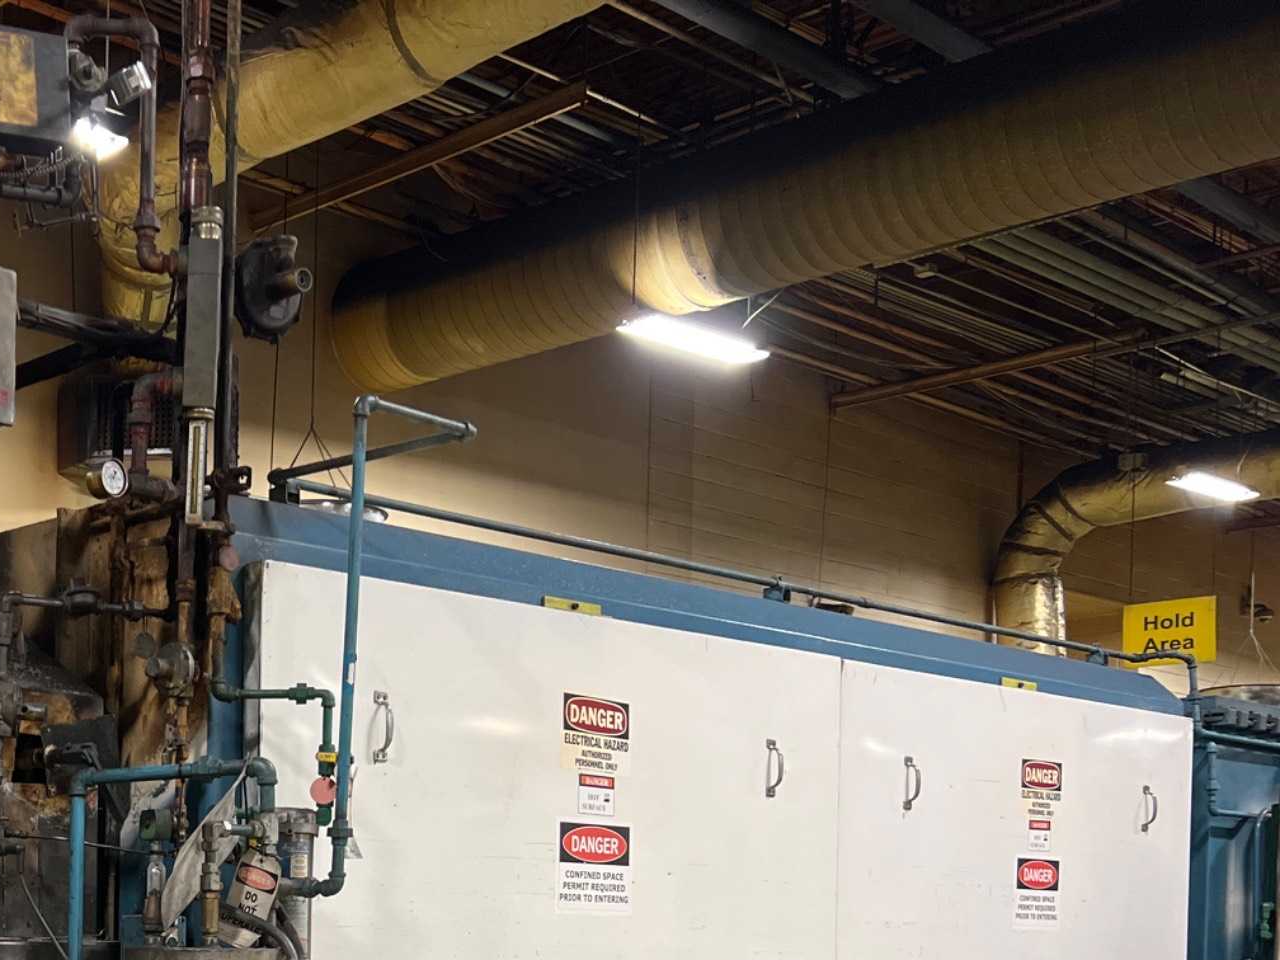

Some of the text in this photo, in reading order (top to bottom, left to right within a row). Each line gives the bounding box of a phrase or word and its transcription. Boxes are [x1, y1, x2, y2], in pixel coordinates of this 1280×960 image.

[1143, 611, 1195, 632] Hold
[1143, 637, 1195, 654] Area
[569, 703, 624, 731] DANGER
[564, 732, 629, 753] ELECTRICAL HAZARD
[1025, 766, 1059, 785] DANGER
[570, 834, 619, 855] DANGER
[565, 870, 624, 882] CONFINED SPACE
[1023, 867, 1053, 883] DANGER
[562, 881, 626, 893] PERMIT REQUIRED
[244, 891, 258, 903] DO
[560, 893, 629, 904] PRIOR TO ENTERING
